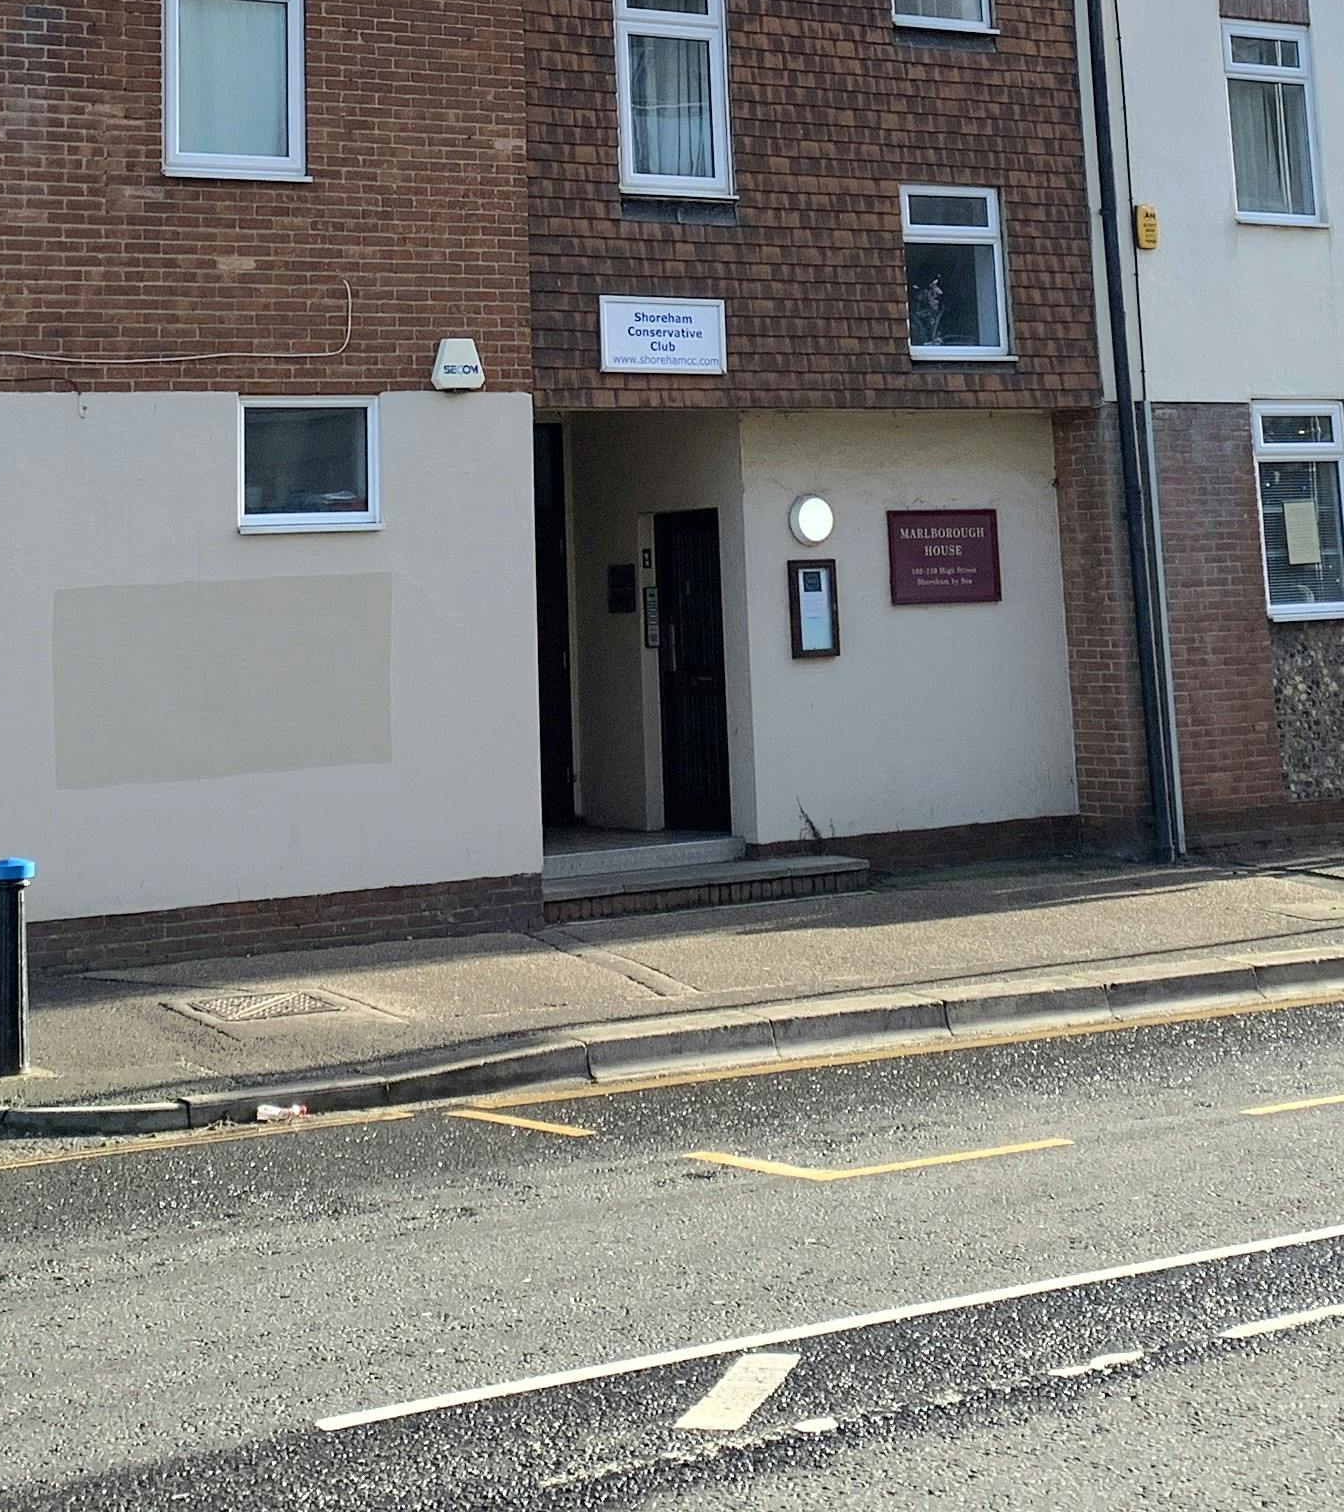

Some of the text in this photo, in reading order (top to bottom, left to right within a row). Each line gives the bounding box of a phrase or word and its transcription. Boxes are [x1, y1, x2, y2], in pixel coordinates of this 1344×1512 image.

[634, 312, 693, 324] Shoreham
[627, 326, 703, 339] Conservative
[650, 341, 676, 352] Club
[613, 354, 719, 367] www.shorehamcc.com
[443, 364, 479, 375] SECOM
[900, 527, 985, 539] MARLBOROUGH
[924, 544, 963, 557] HOUSE
